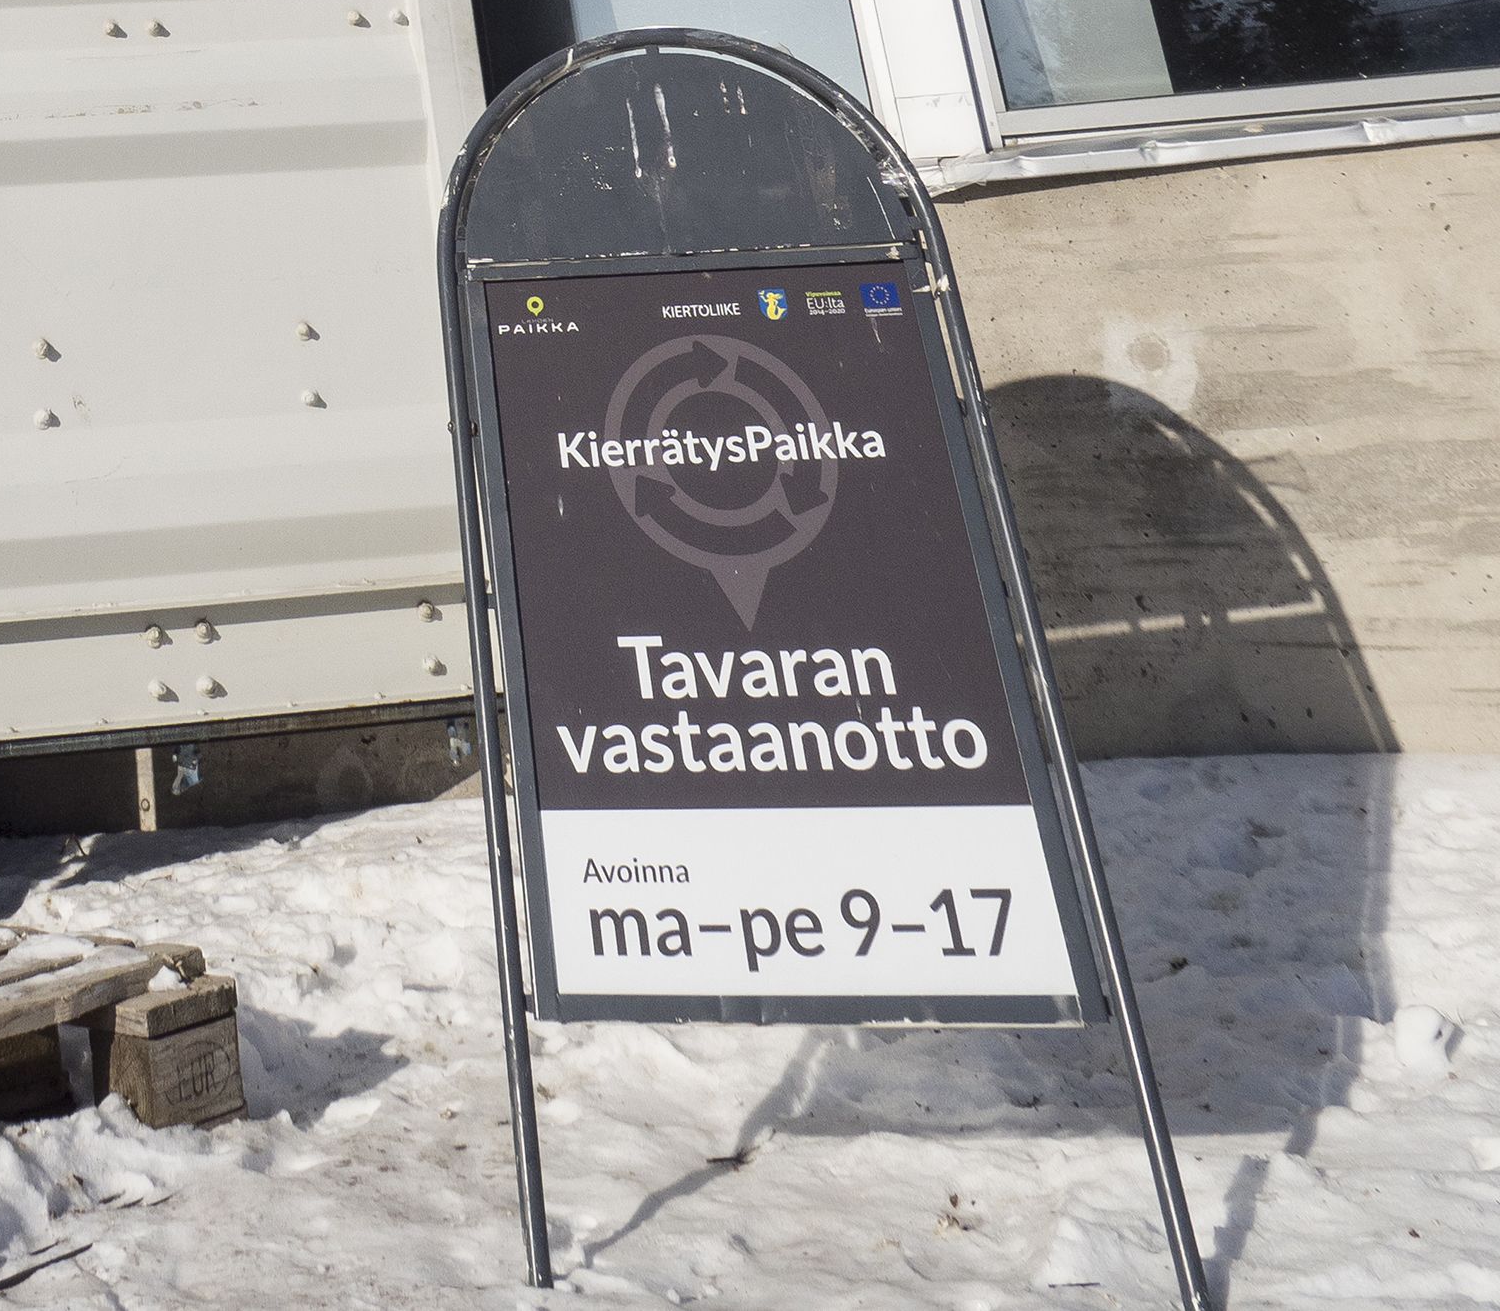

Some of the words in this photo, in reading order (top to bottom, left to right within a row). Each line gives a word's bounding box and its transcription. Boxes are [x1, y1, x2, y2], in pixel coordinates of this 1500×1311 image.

[661, 303, 741, 318] KIERTOLIIKE
[806, 296, 846, 309] EU:lta
[498, 322, 579, 335] PAIKKA
[557, 421, 887, 472] KierrätysPaikka
[616, 634, 898, 702] Tavaran
[556, 706, 990, 775] vastaanotto
[582, 855, 690, 885] Avoinna
[589, 902, 826, 973] ma-pe
[840, 887, 1013, 959] 9-17
